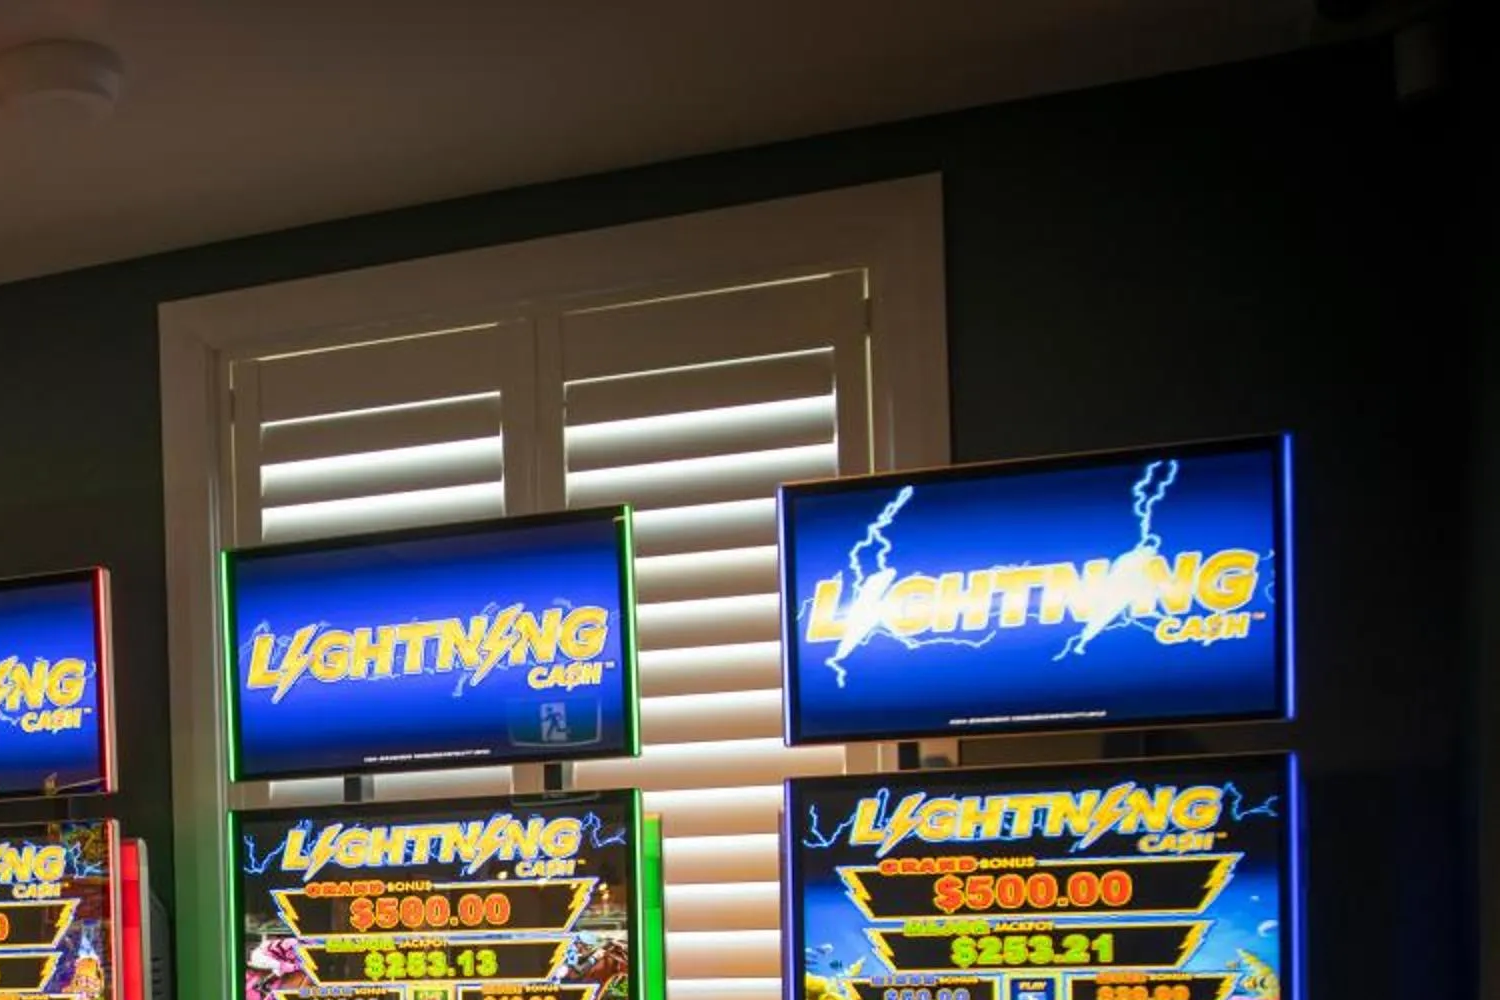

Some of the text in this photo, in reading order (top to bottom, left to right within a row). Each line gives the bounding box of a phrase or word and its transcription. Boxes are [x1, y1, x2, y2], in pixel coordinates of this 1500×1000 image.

[247, 602, 609, 703] LIGHTNING
[850, 782, 1223, 857] LIGHTNING
[281, 813, 581, 881] LIGHTNING
[878, 856, 1036, 875] GRAND BONUS
[387, 881, 432, 892] BONUS
[933, 870, 1132, 914] $500.00
[350, 893, 510, 932] $500.00
[994, 920, 1055, 931] JACKPOT
[398, 939, 450, 948] JACKPOT
[951, 933, 1114, 968] $253.21
[364, 949, 498, 981] $253.13
